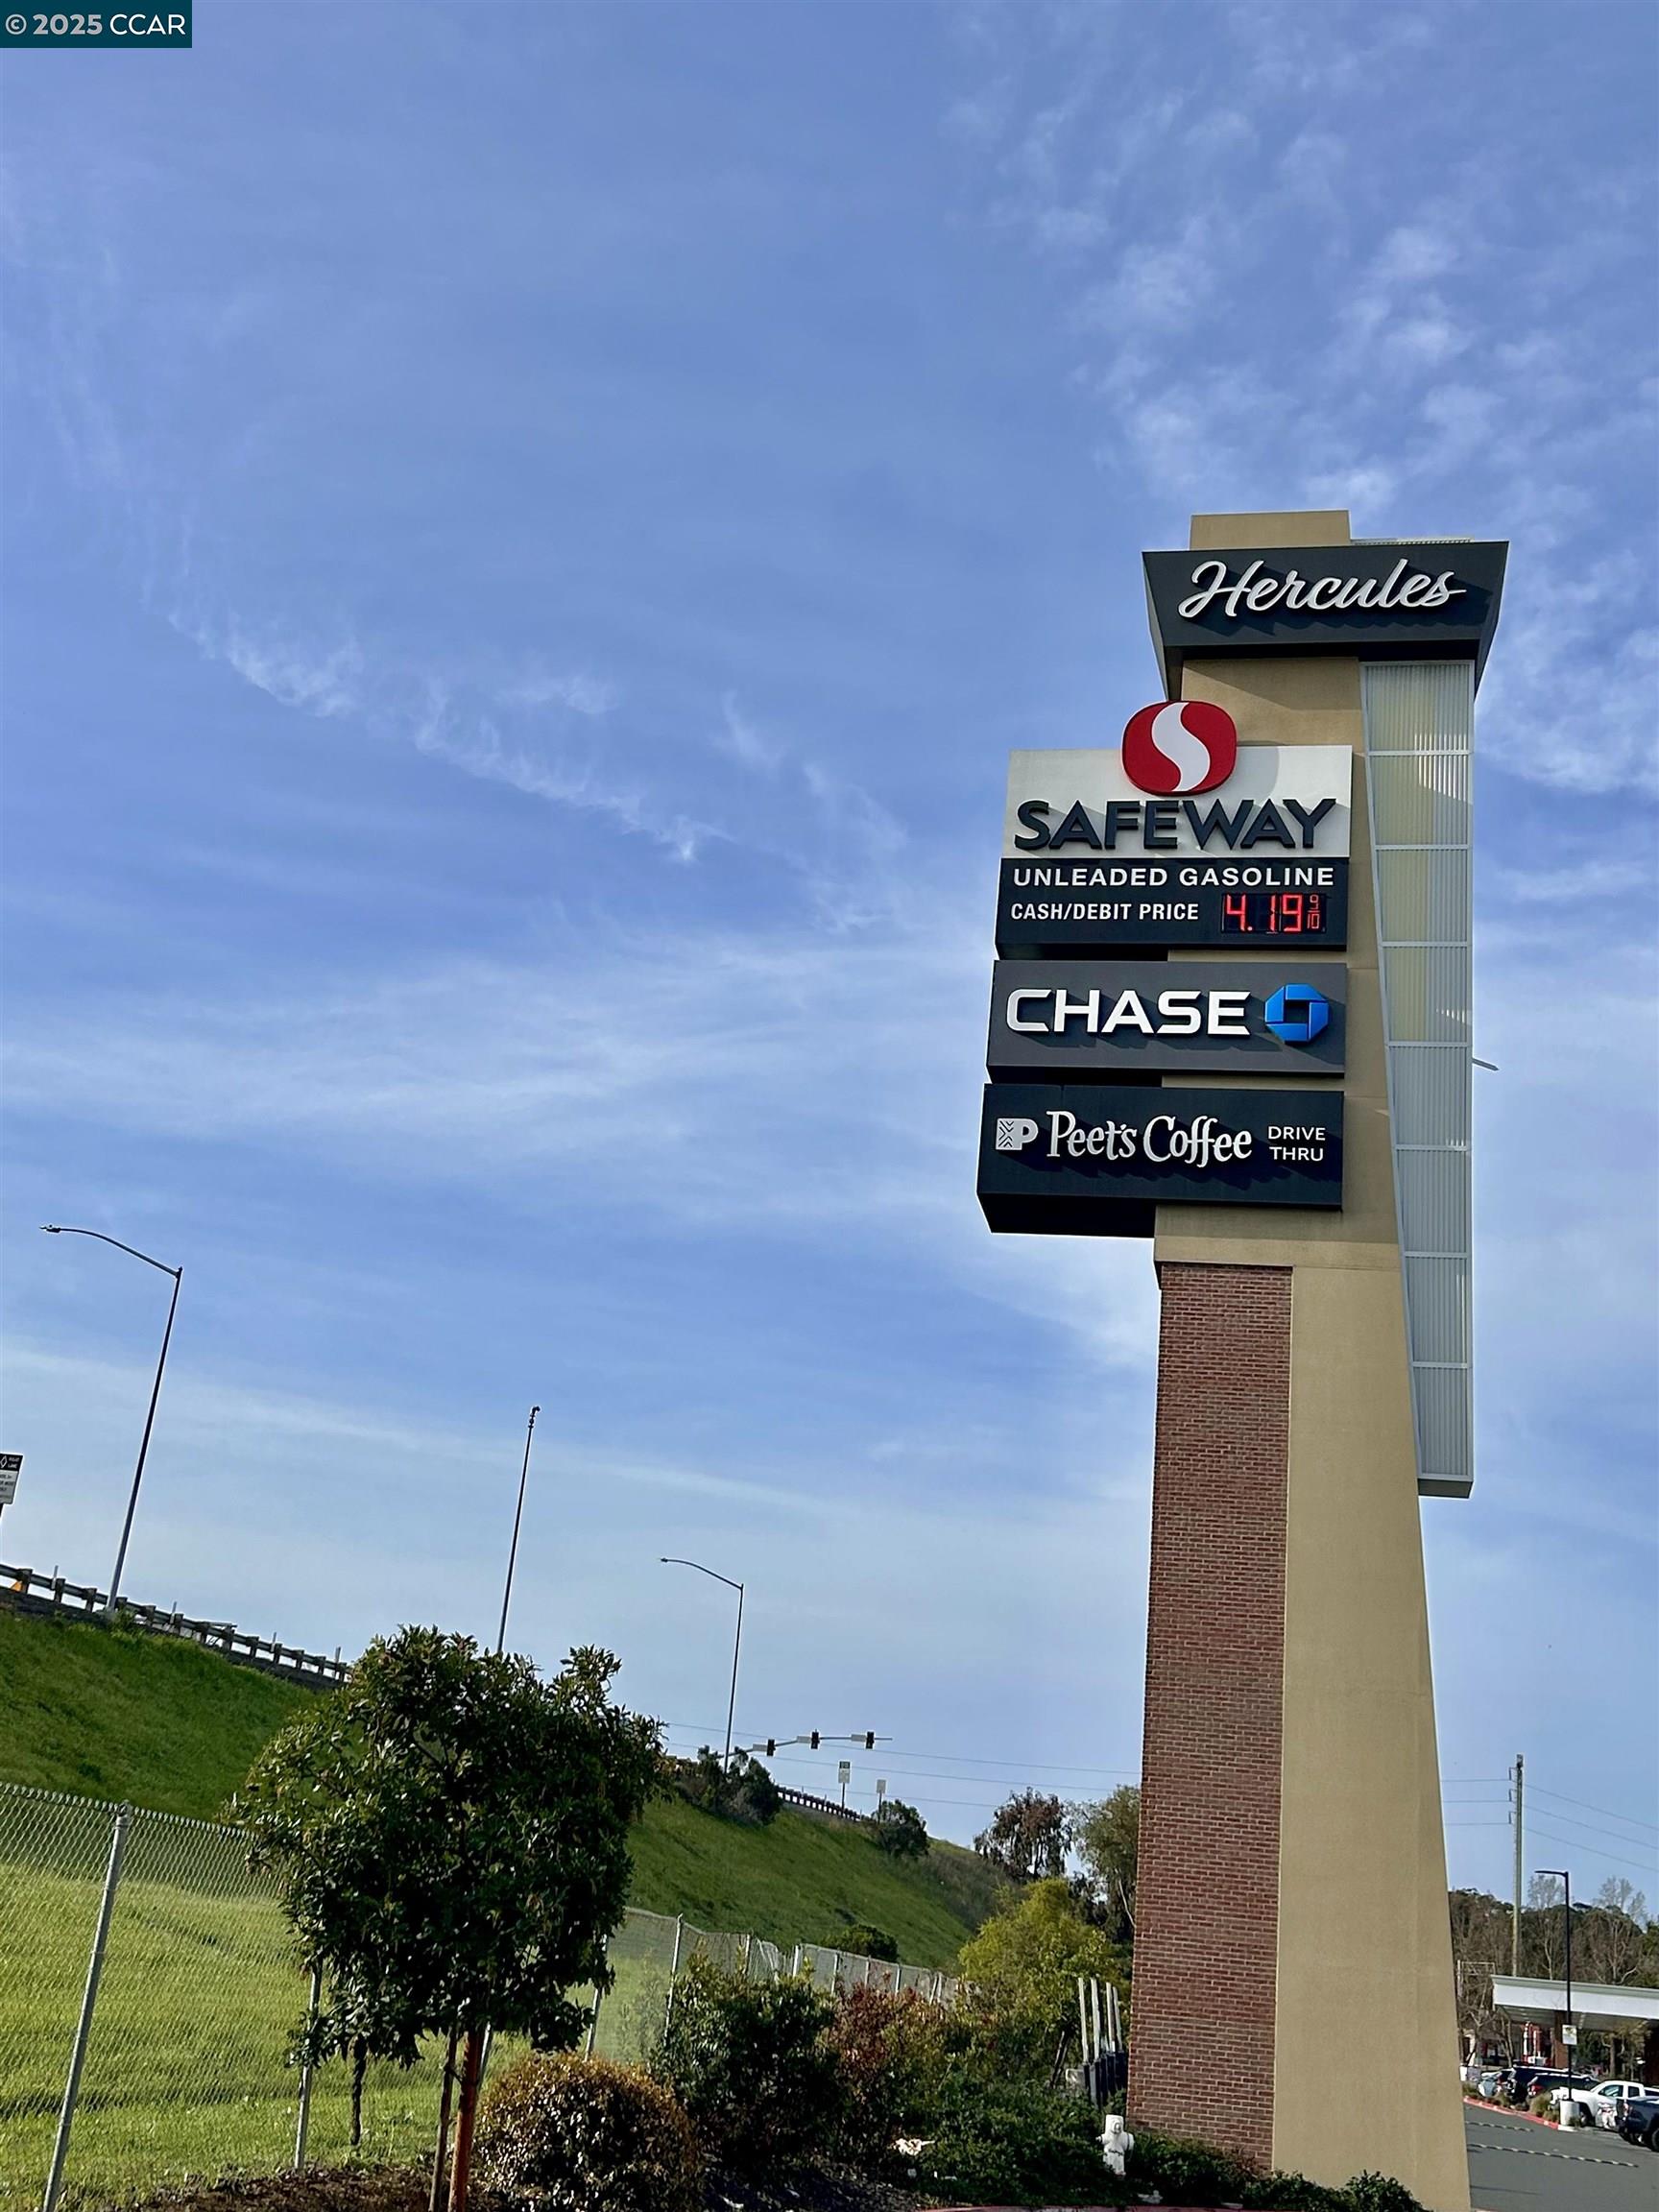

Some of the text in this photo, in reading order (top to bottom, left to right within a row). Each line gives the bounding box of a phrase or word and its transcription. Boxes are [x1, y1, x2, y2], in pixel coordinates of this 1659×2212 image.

[1178, 559, 1467, 617] Hercules
[1014, 799, 1336, 850] SAFEWAY
[1013, 867, 1334, 886] UNLEADED GASOLINE
[1011, 903, 1199, 921] CASH/DEBIT PRICE
[1226, 894, 1303, 932] 4.19
[1006, 989, 1250, 1035] CHASE
[1046, 1111, 1137, 1160] Peet's
[1142, 1116, 1252, 1167] Coffee
[1267, 1126, 1326, 1141] DRIVE
[1269, 1146, 1324, 1162] THRU
